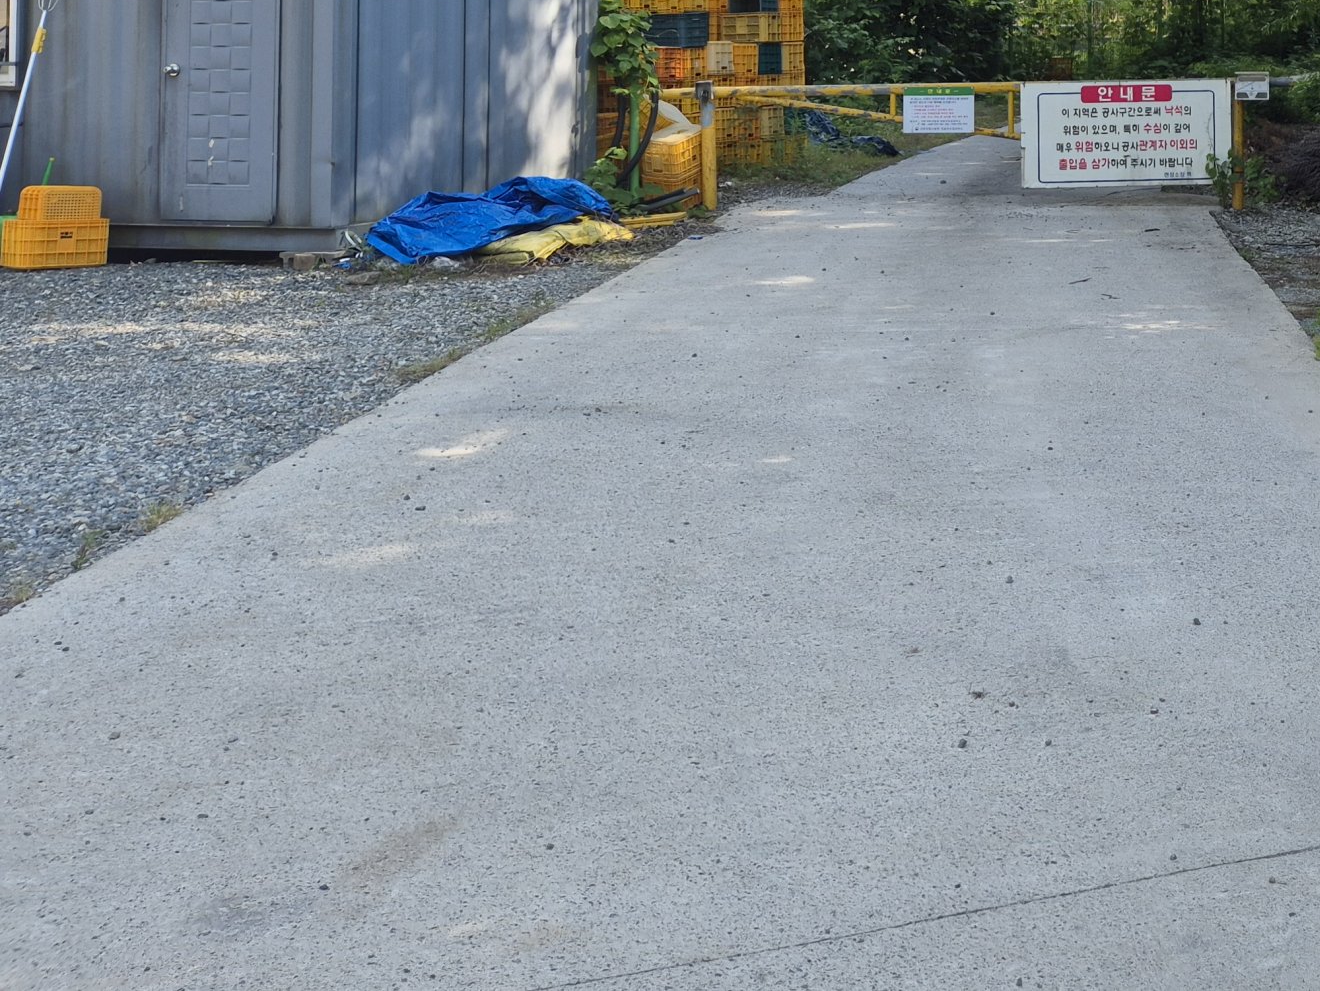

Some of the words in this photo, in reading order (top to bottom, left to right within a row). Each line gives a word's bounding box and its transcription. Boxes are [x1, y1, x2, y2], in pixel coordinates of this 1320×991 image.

[1061, 108, 1070, 118] 이
[1073, 107, 1098, 118] 지역은
[1102, 106, 1161, 118] 공사구간으로써
[1164, 105, 1192, 116] 낙석의
[1063, 125, 1089, 135] 위험이
[1092, 124, 1120, 135] 있으며,
[1123, 124, 1140, 134] 특히
[1143, 123, 1171, 134] 수심이
[1174, 123, 1191, 134] 깊어
[1056, 142, 1073, 153] 매우
[1074, 140, 1119, 153] 위험하오니
[1169, 138, 1198, 150] 이외의
[1058, 158, 1088, 170] 출입을
[1091, 157, 1127, 170] 삼가하여
[1130, 157, 1156, 169] 주시기
[1159, 156, 1193, 168] 바랍니다
